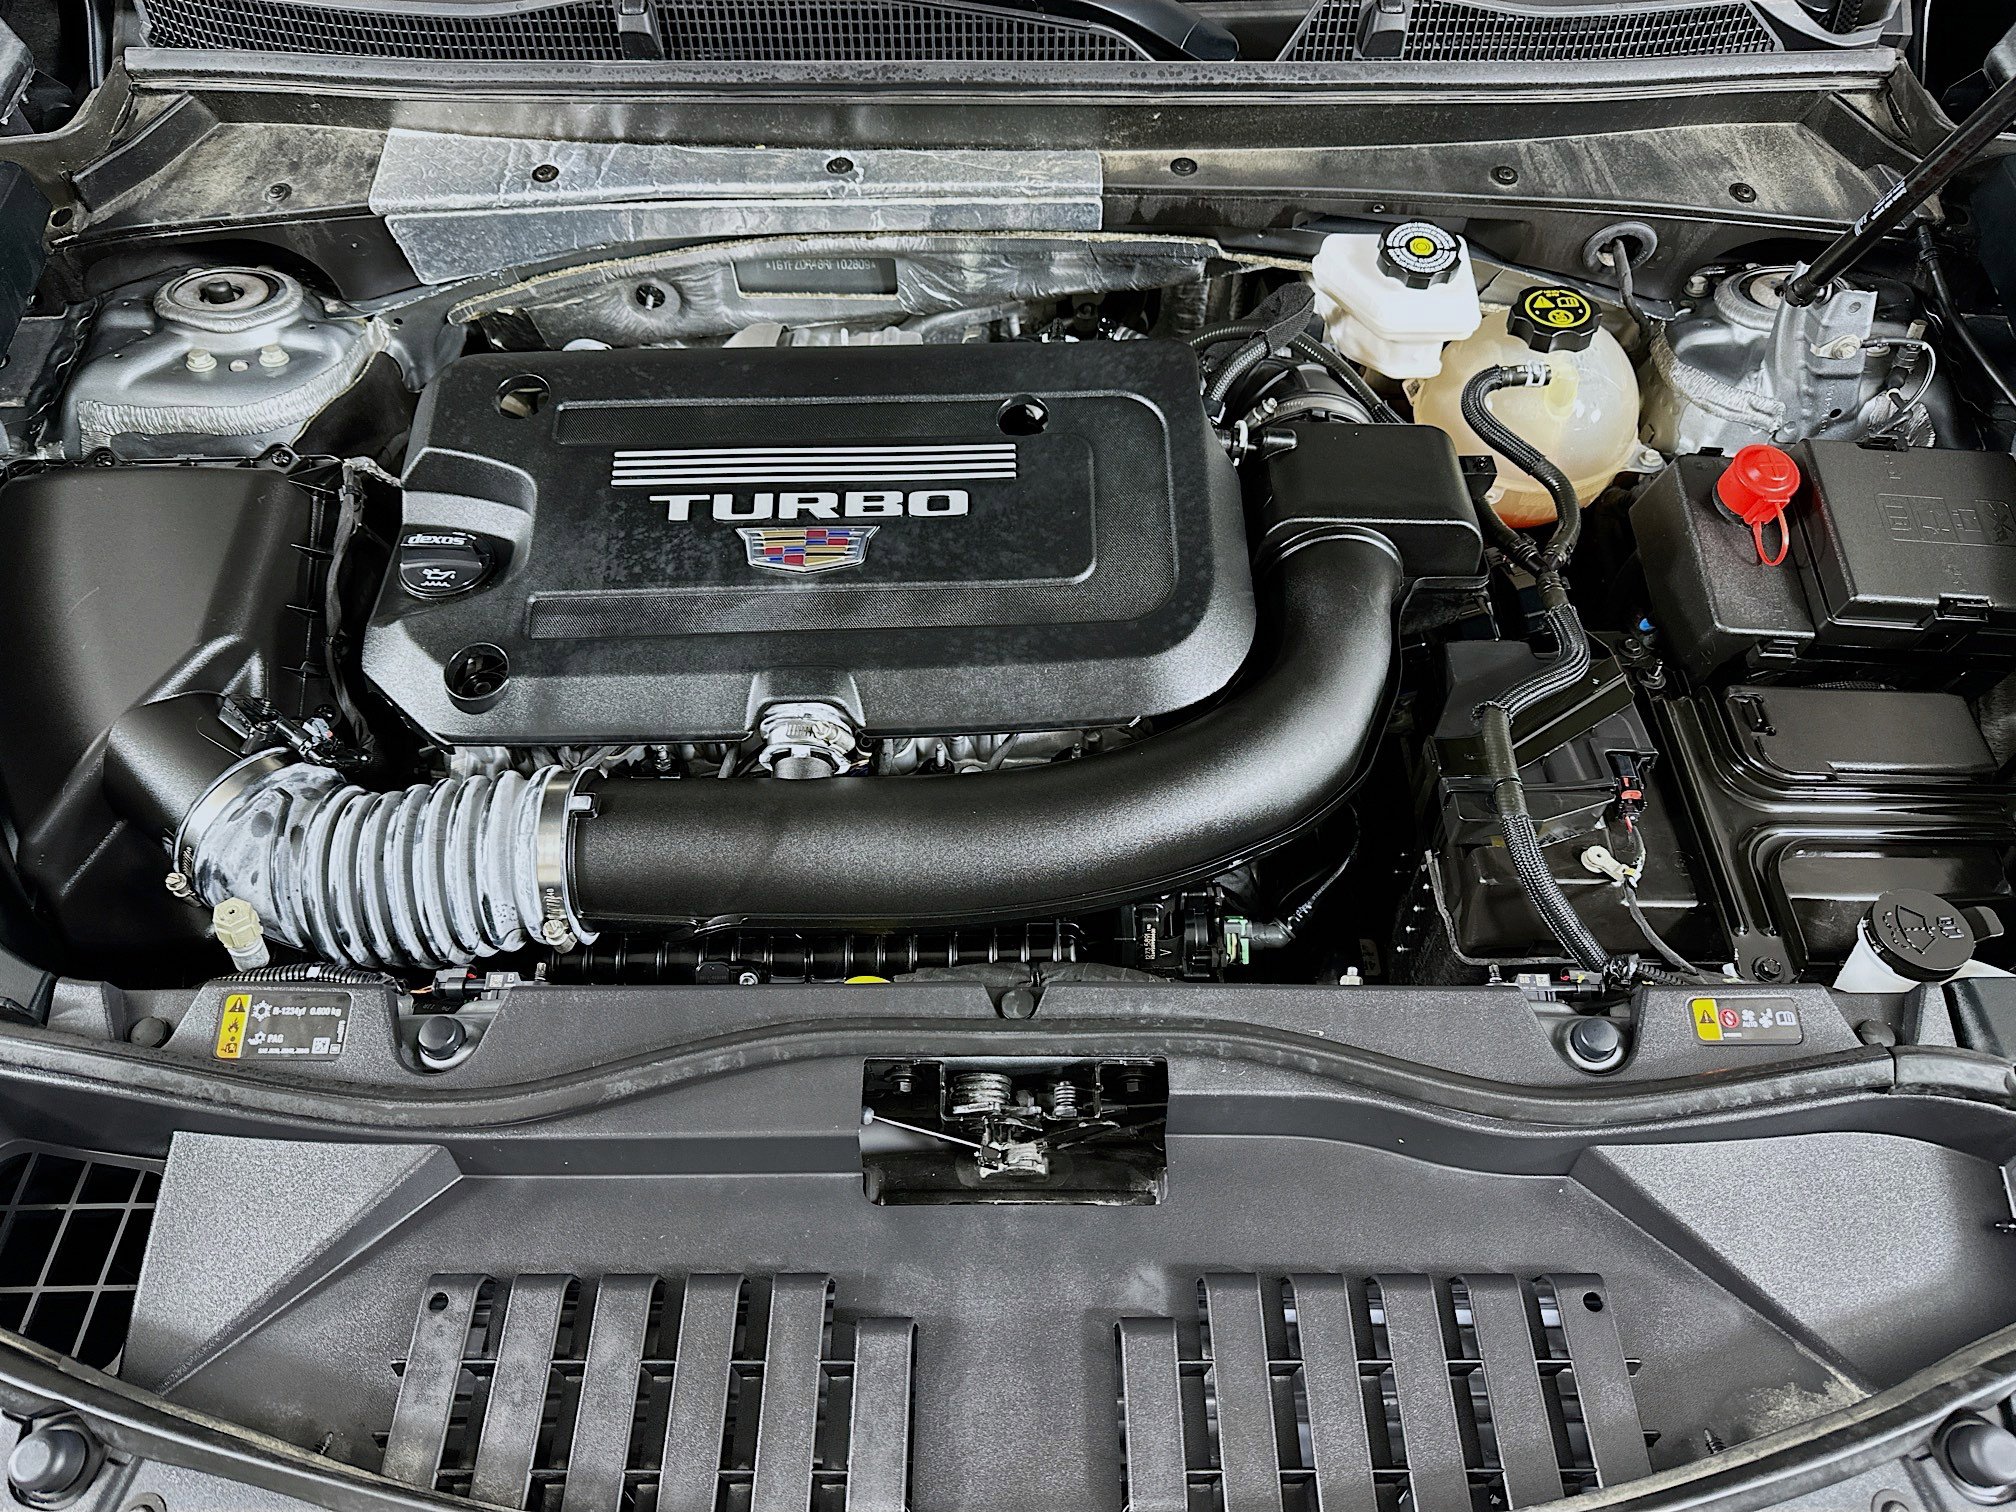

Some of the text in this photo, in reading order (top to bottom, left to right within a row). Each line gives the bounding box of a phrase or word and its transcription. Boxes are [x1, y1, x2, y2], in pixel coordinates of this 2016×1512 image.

[649, 489, 969, 522] TURBO
[407, 533, 468, 546] dexos
[507, 974, 515, 982] B
[266, 1033, 285, 1043] PAG
